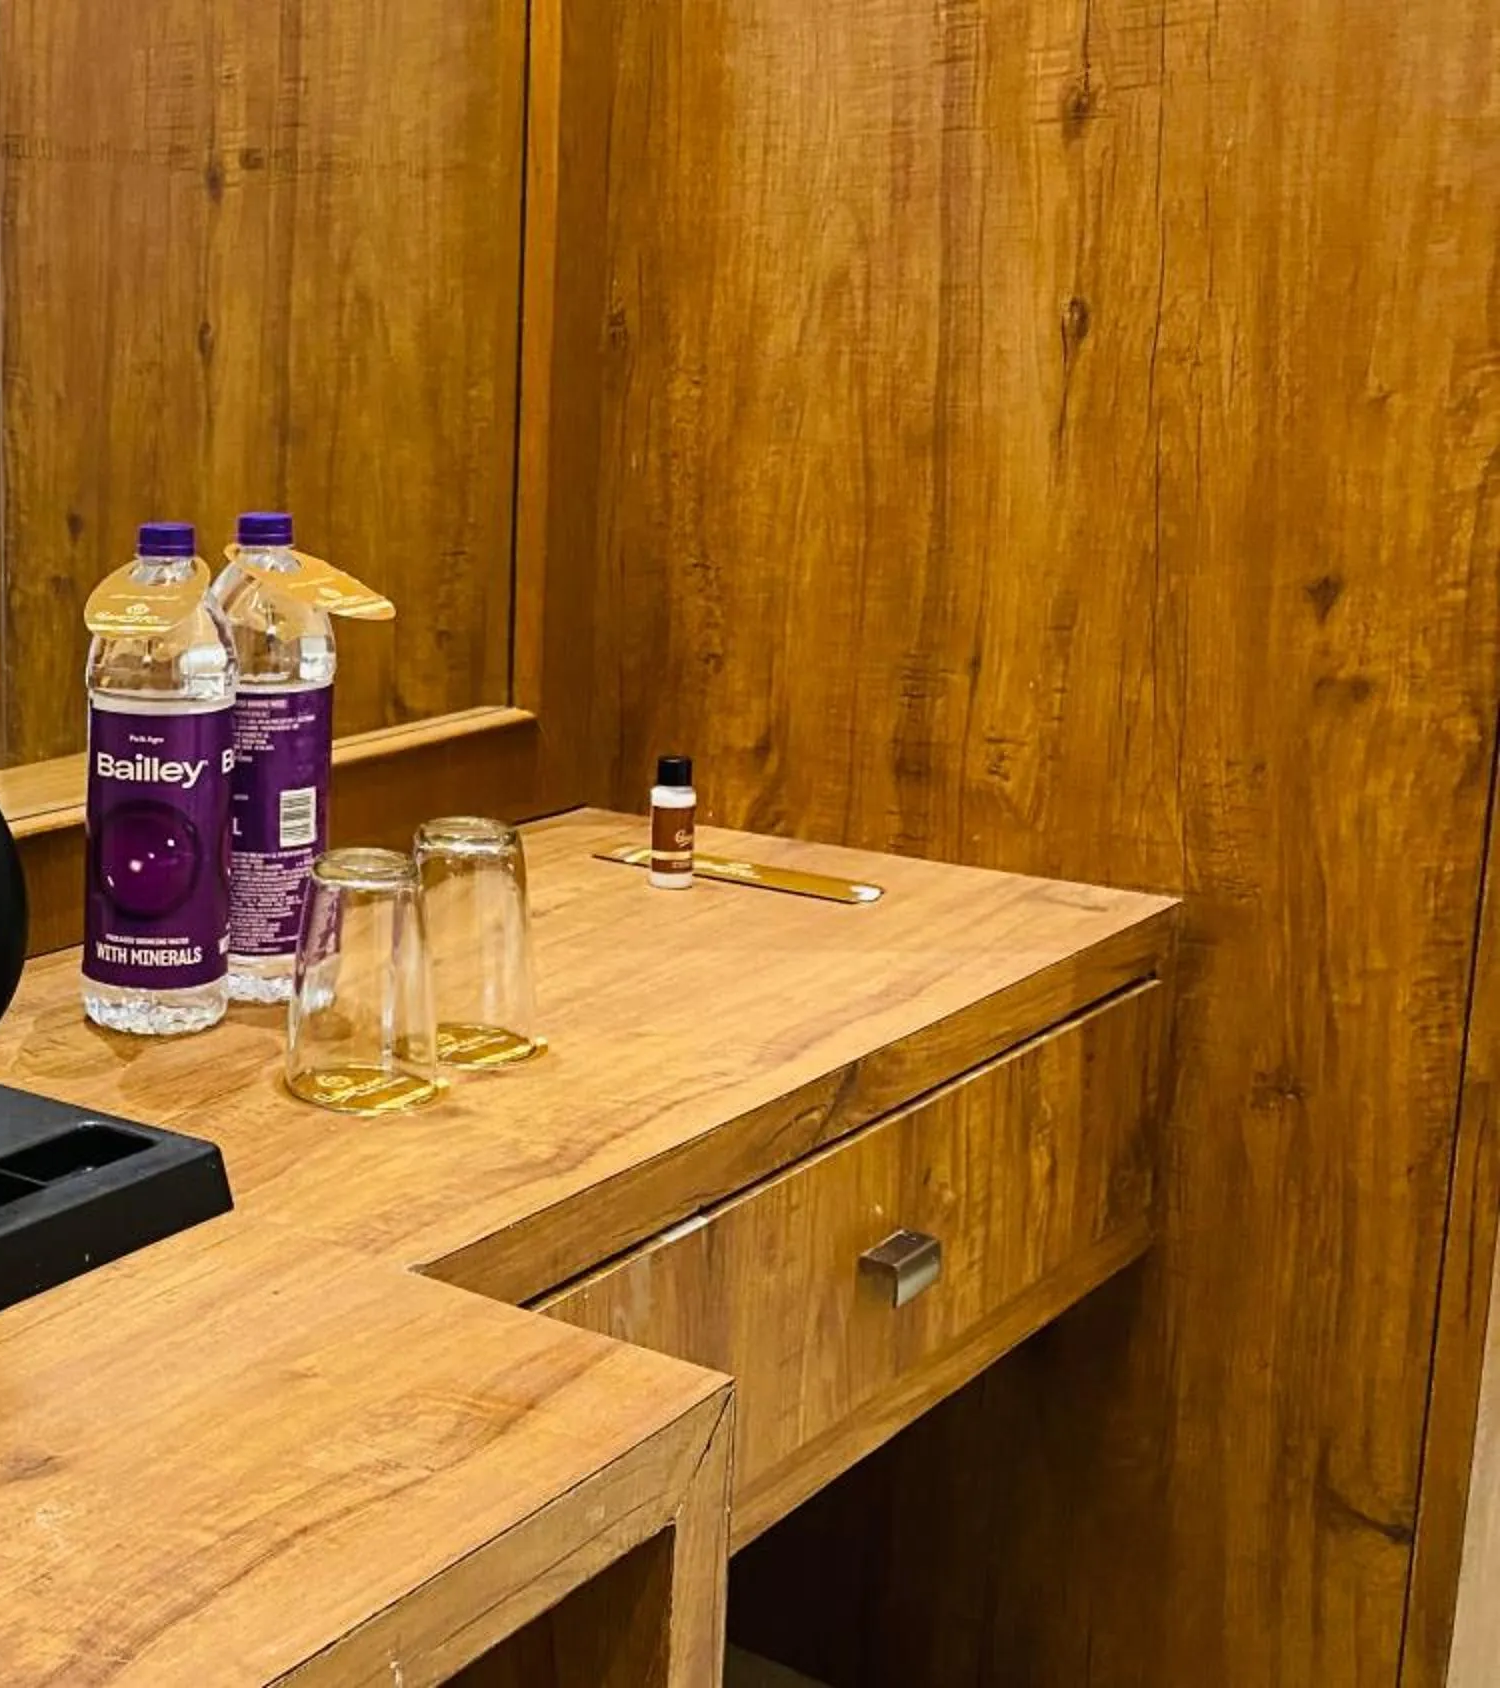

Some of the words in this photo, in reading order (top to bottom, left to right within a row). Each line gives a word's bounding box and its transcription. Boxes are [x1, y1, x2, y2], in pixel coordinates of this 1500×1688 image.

[97, 752, 203, 789] Bailley
[96, 940, 128, 965] WITH
[131, 945, 203, 967] MINERALS
